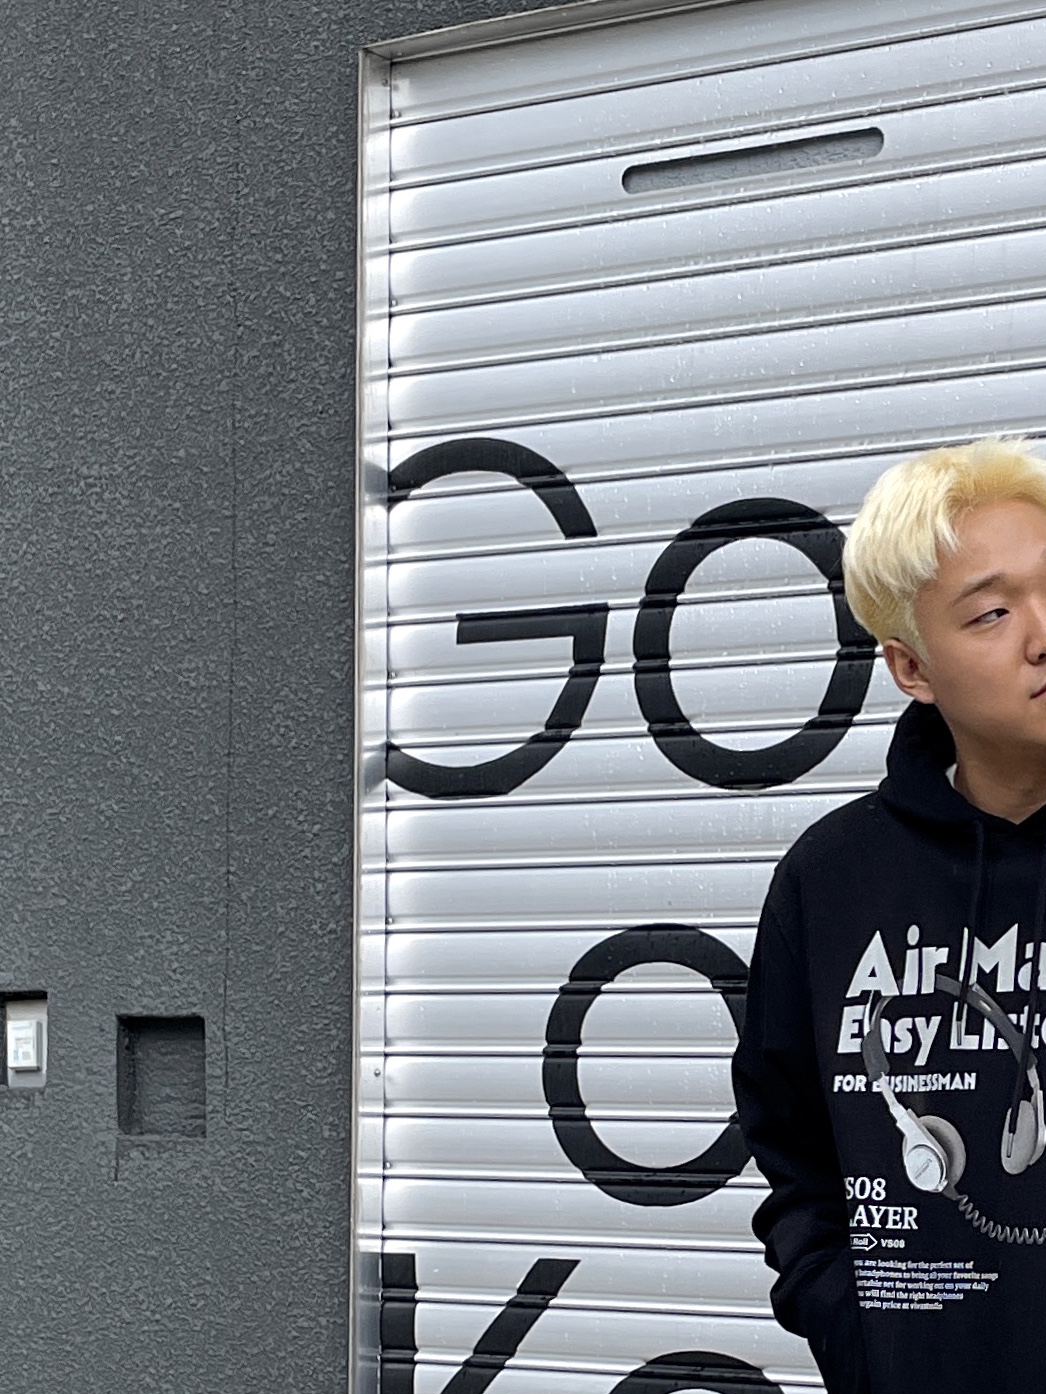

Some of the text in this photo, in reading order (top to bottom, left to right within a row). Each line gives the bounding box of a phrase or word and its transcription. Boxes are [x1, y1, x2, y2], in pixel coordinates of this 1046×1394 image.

[846, 925, 949, 998] Air
[833, 1074, 867, 1092] FOR
[849, 1204, 919, 1230] AYER
